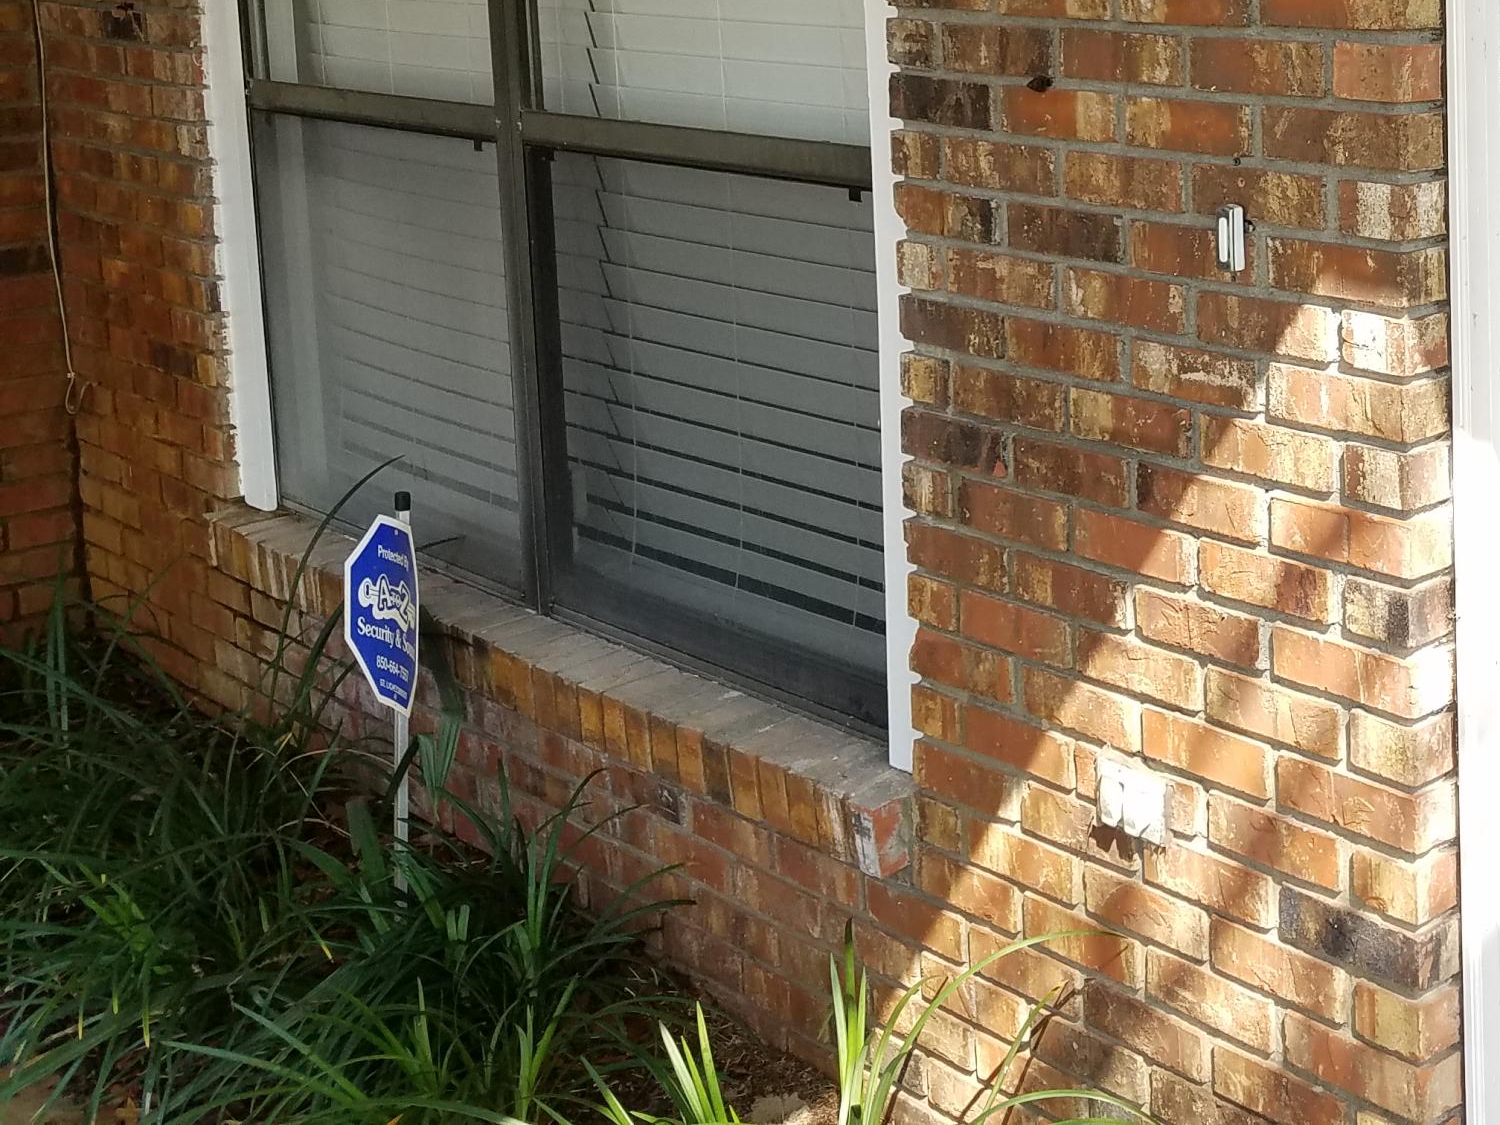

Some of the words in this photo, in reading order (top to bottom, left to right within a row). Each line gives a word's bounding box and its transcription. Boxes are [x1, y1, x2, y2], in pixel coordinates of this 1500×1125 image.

[377, 544, 403, 564] Protected
[357, 616, 394, 649] Security
[395, 628, 401, 649] &
[376, 655, 409, 682] 850-664-7
